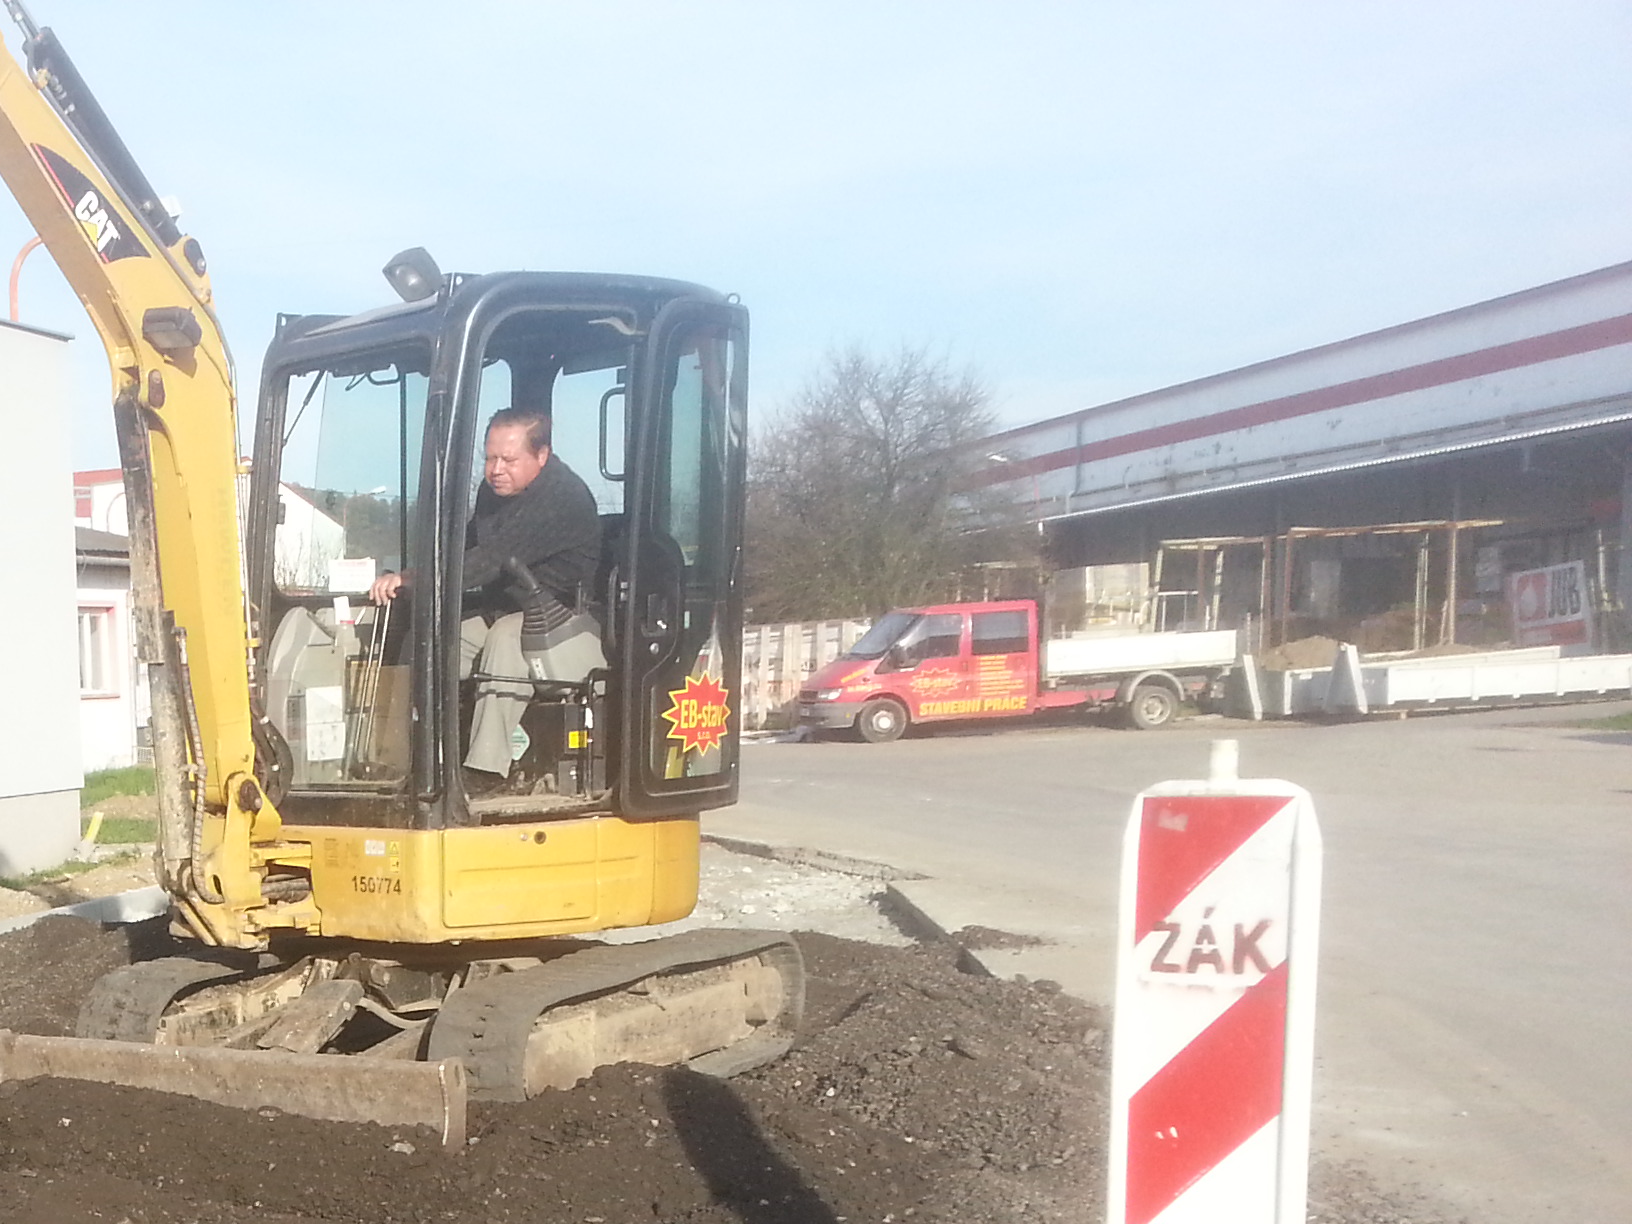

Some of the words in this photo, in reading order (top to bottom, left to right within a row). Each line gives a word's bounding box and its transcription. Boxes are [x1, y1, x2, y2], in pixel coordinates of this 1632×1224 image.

[74, 191, 120, 252] CAT
[1548, 566, 1582, 619] JUB
[680, 699, 724, 729] EB-stav
[351, 875, 402, 896] 150774
[1150, 905, 1273, 975] ZÁK
